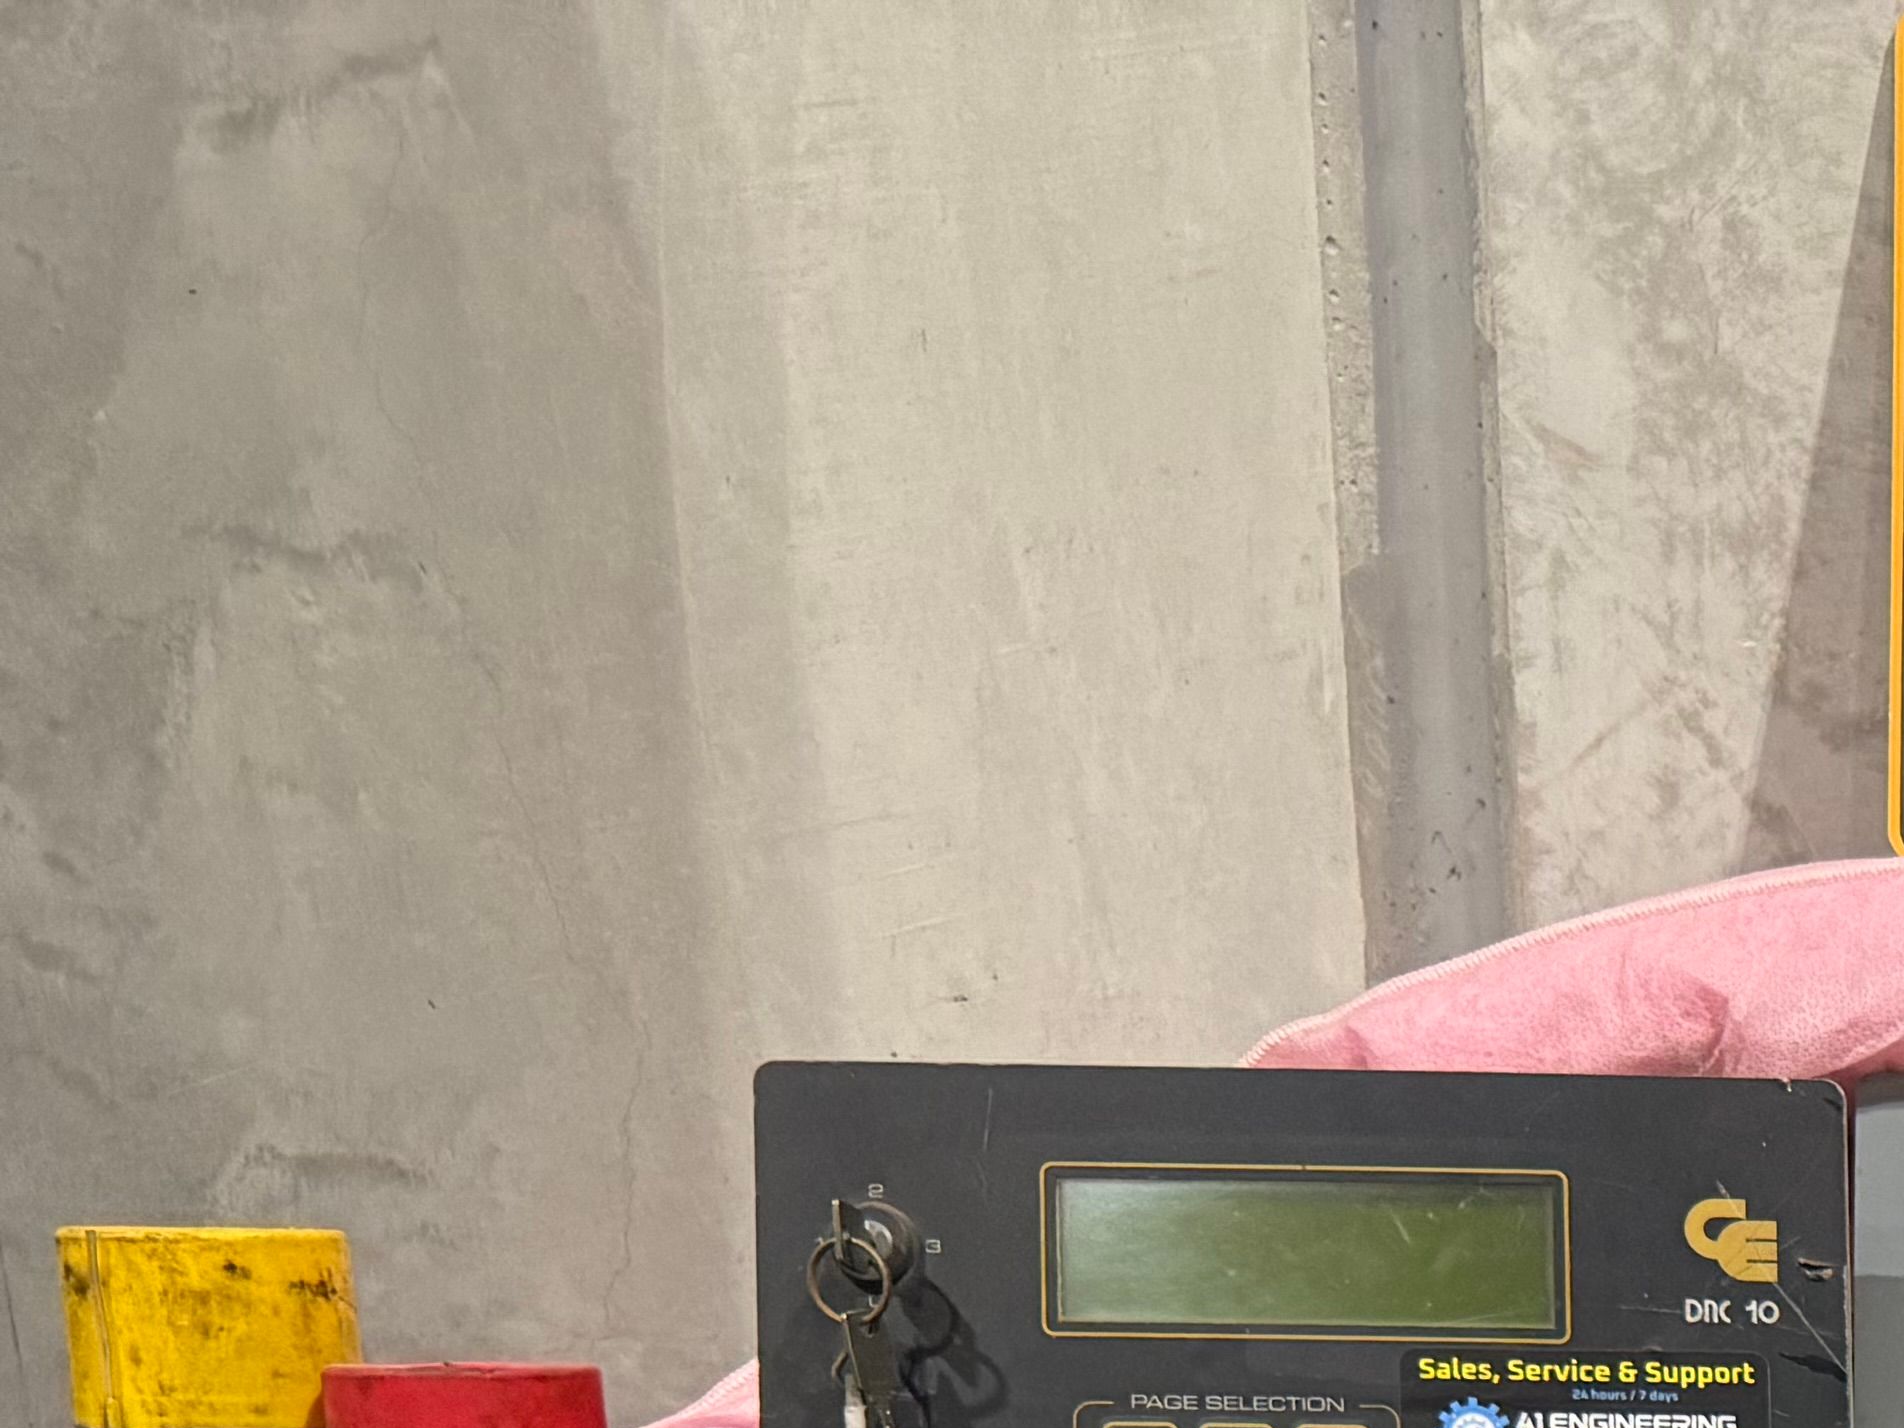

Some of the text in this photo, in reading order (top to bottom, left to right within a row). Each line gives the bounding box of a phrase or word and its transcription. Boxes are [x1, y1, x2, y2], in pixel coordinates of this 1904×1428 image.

[1746, 1301, 1779, 1325] 10
[1419, 1357, 1755, 1389] Sales, Service & Support
[1131, 1395, 1344, 1413] PAGE SELECTION
